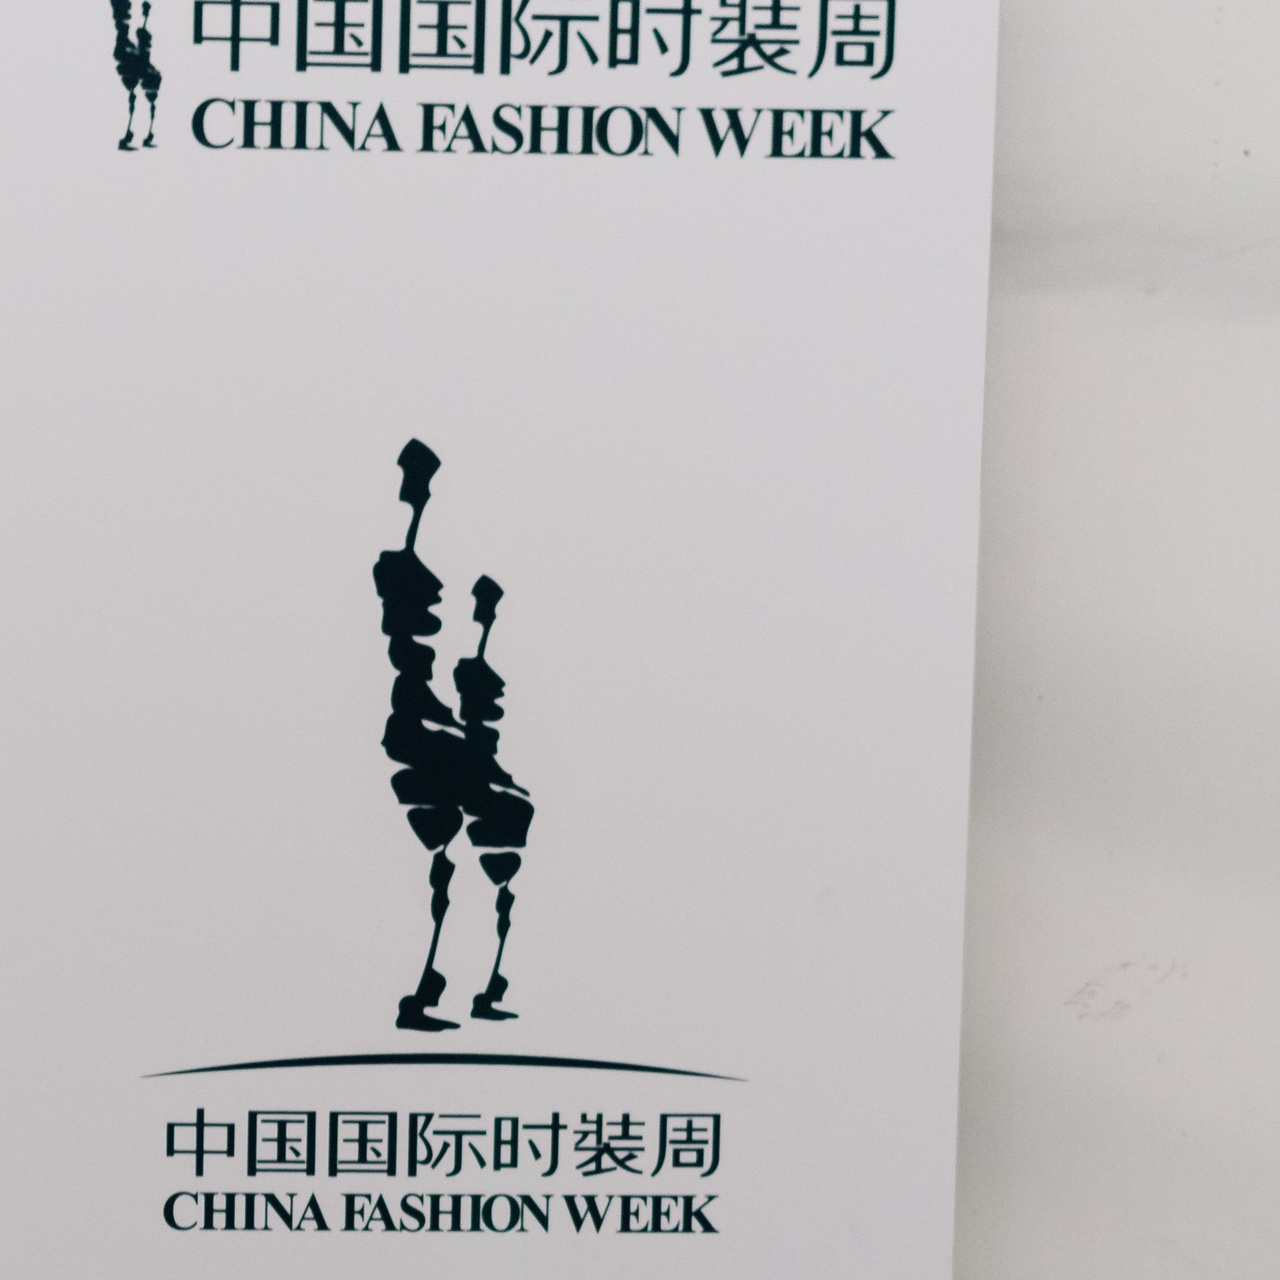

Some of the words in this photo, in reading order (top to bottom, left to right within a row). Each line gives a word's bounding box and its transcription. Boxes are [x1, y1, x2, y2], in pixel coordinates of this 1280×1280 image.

[191, 97, 402, 151] CHINA
[418, 103, 684, 156] FASHION
[698, 107, 894, 158] WEEK
[162, 1191, 331, 1231] CHINA
[341, 1193, 553, 1232] FASHION
[562, 1194, 719, 1233] WEEK
